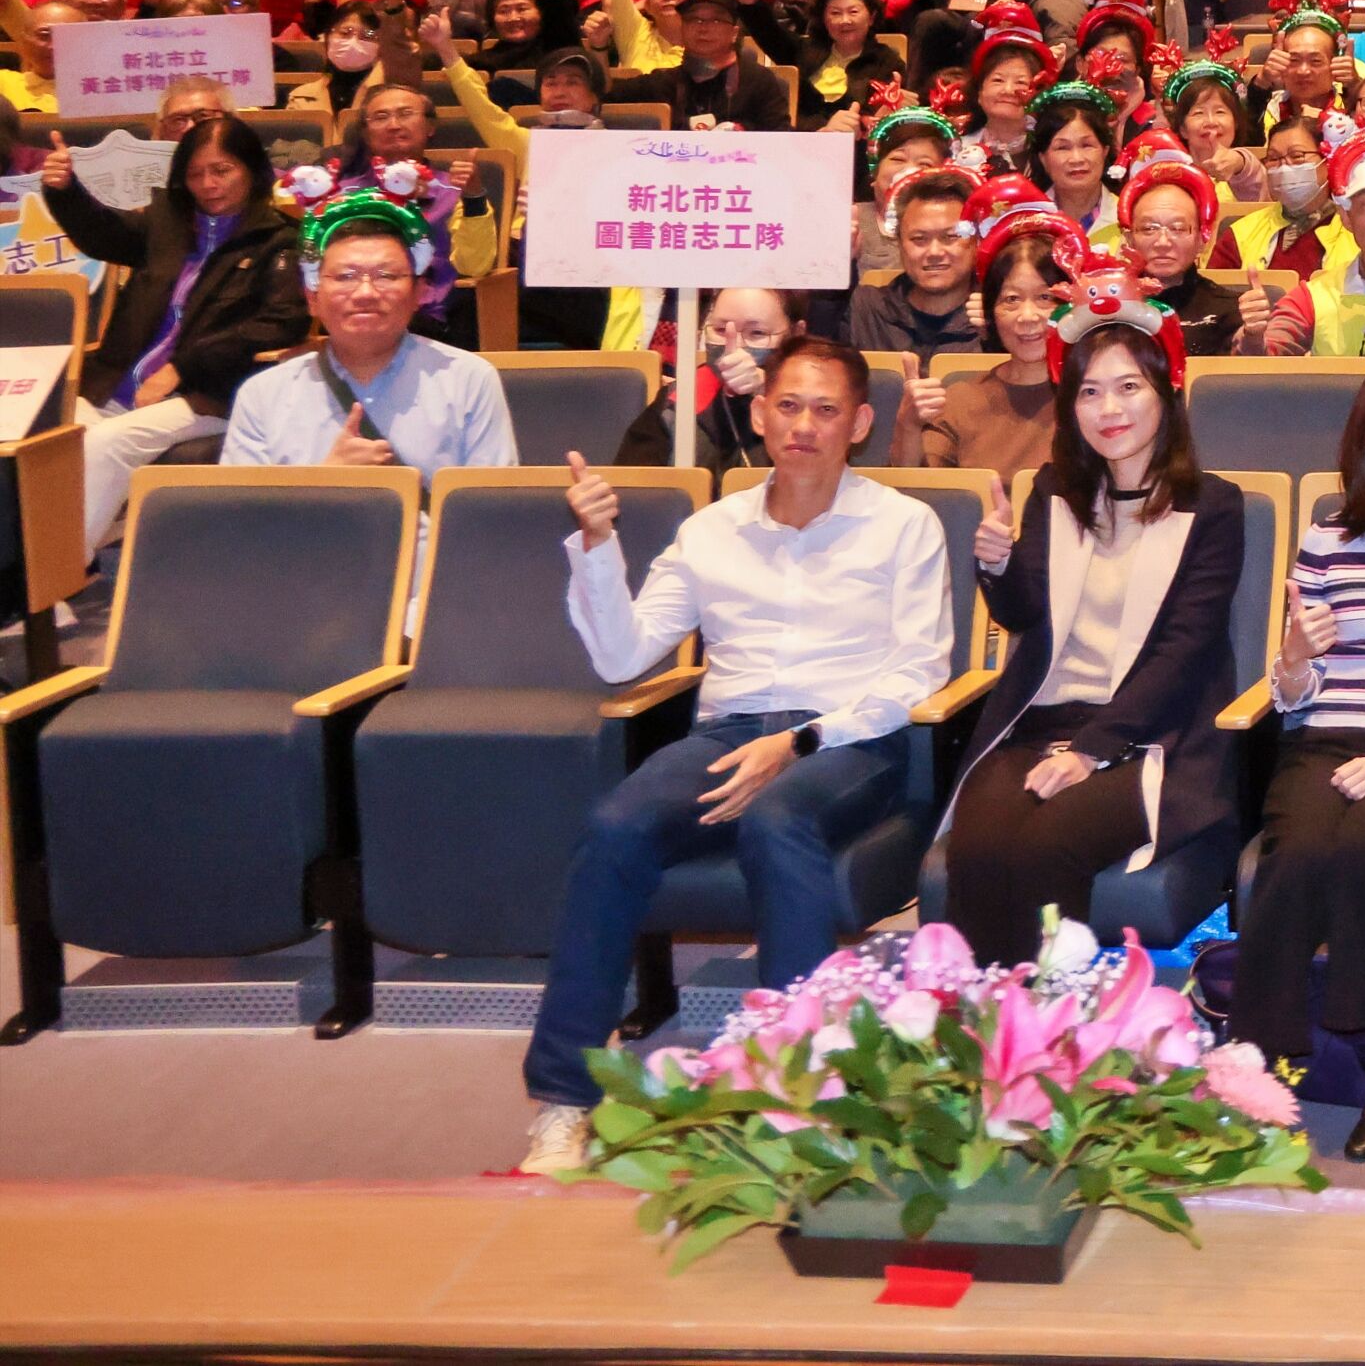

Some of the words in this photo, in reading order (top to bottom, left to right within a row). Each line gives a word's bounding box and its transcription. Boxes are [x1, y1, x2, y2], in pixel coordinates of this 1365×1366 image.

[121, 49, 209, 70] 新北市立
[627, 184, 754, 214] 新北市立
[594, 220, 785, 251] 圖書館志工隊
